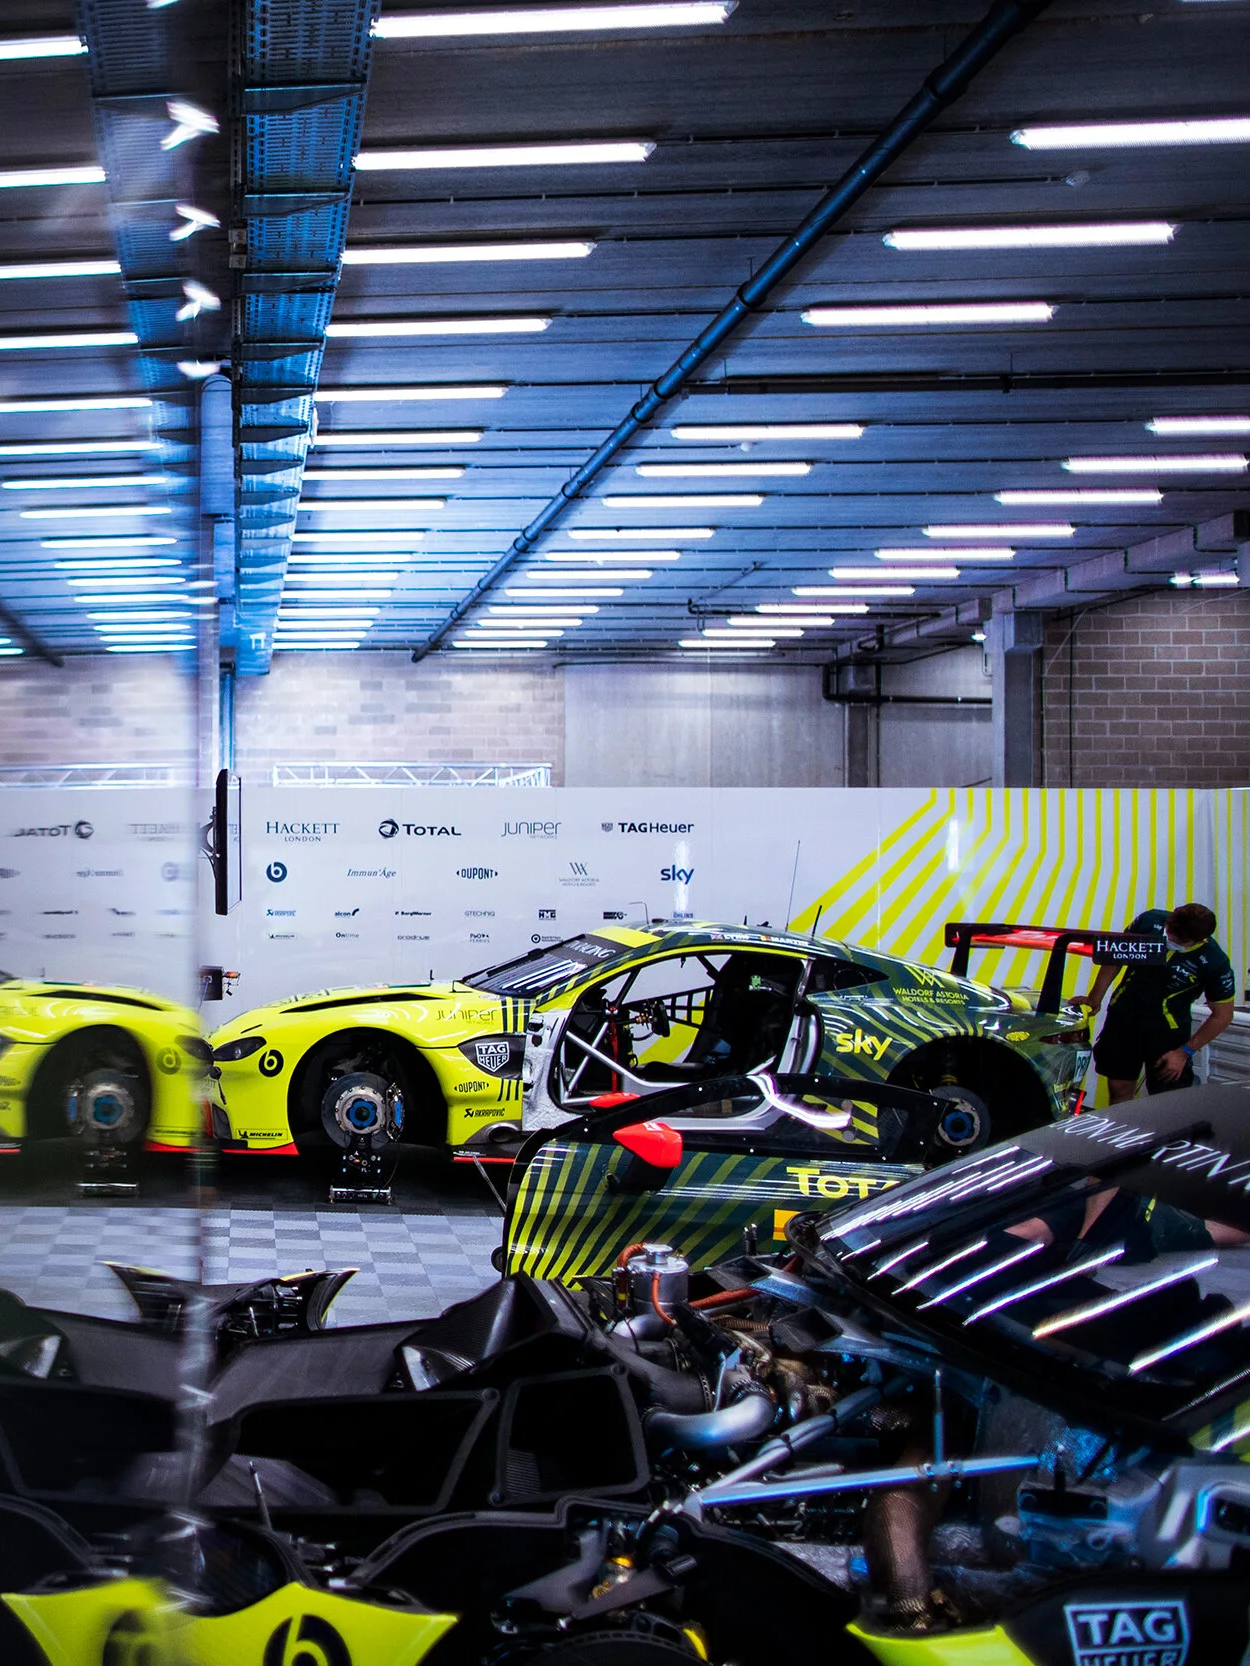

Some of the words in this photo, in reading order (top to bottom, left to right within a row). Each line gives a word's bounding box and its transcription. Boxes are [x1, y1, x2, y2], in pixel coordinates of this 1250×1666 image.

[265, 821, 340, 835] HACKETT
[402, 823, 462, 837] TOTAL
[660, 864, 695, 885] sky
[1096, 940, 1165, 953] HACKETT
[478, 1044, 506, 1055] TAG
[835, 1028, 894, 1061] sky
[478, 1055, 508, 1070] HEUER
[1076, 1610, 1177, 1646] TAG
